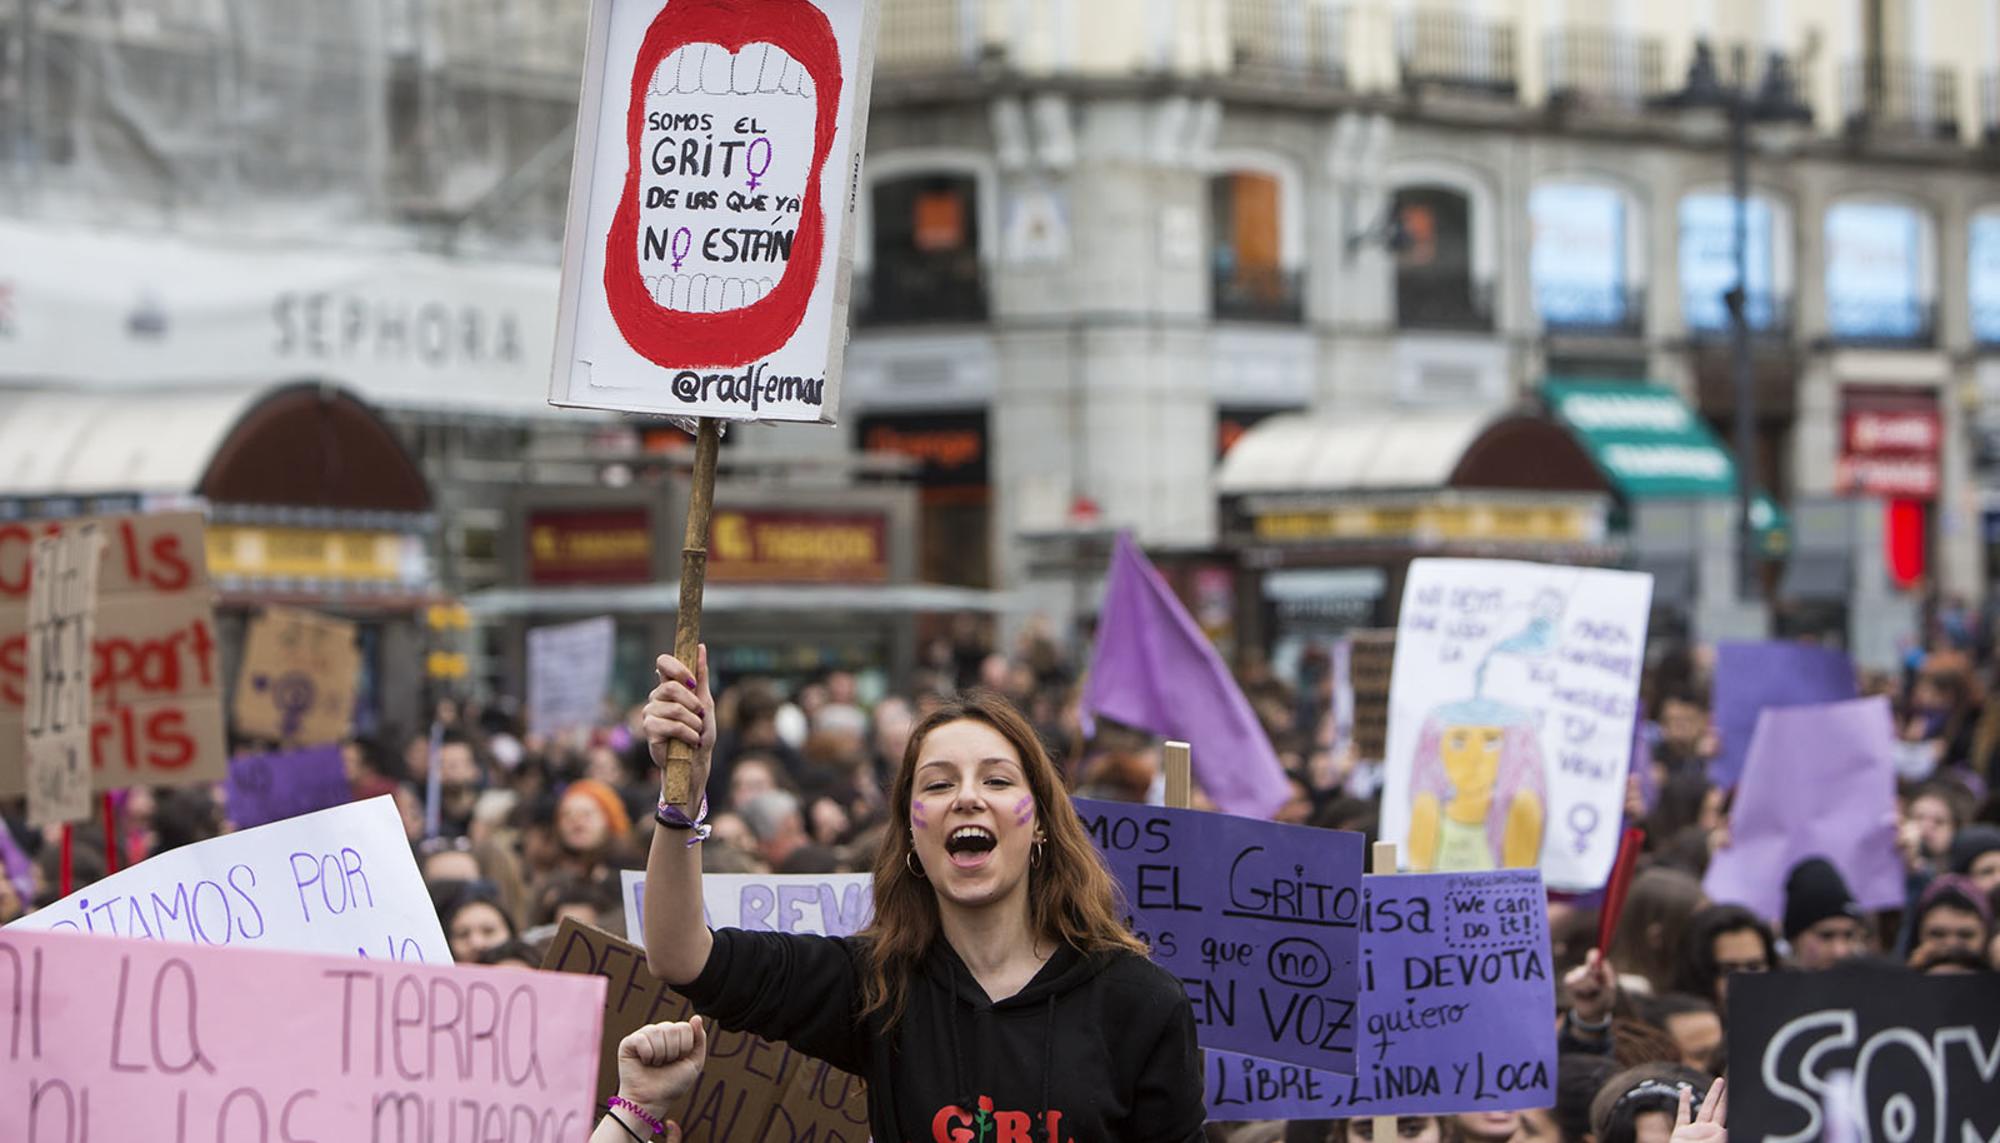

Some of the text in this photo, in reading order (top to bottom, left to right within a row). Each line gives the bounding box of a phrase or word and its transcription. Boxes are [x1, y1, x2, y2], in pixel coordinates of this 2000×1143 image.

[649, 113, 767, 134] SOMOS EL
[646, 187, 800, 213] DE LAS QUE YA
[703, 216, 795, 262] ESTÁN
[271, 293, 526, 367] SEPHORA
[1078, 815, 1171, 853] MOS
[51, 847, 373, 946] iTAMOS POR
[740, 883, 873, 937] REV
[1137, 864, 1202, 911] EL
[1453, 895, 1530, 914] We can
[1360, 888, 1435, 933] isa
[1500, 914, 1531, 936] it!
[1201, 937, 1253, 972] que
[1278, 952, 1318, 979] no
[1405, 947, 1545, 991] DEVOTA
[1259, 987, 1355, 1052] VOZ
[1367, 998, 1470, 1061] quiero
[1452, 1062, 1469, 1094] Y
[1474, 1052, 1548, 1101] LOCA
